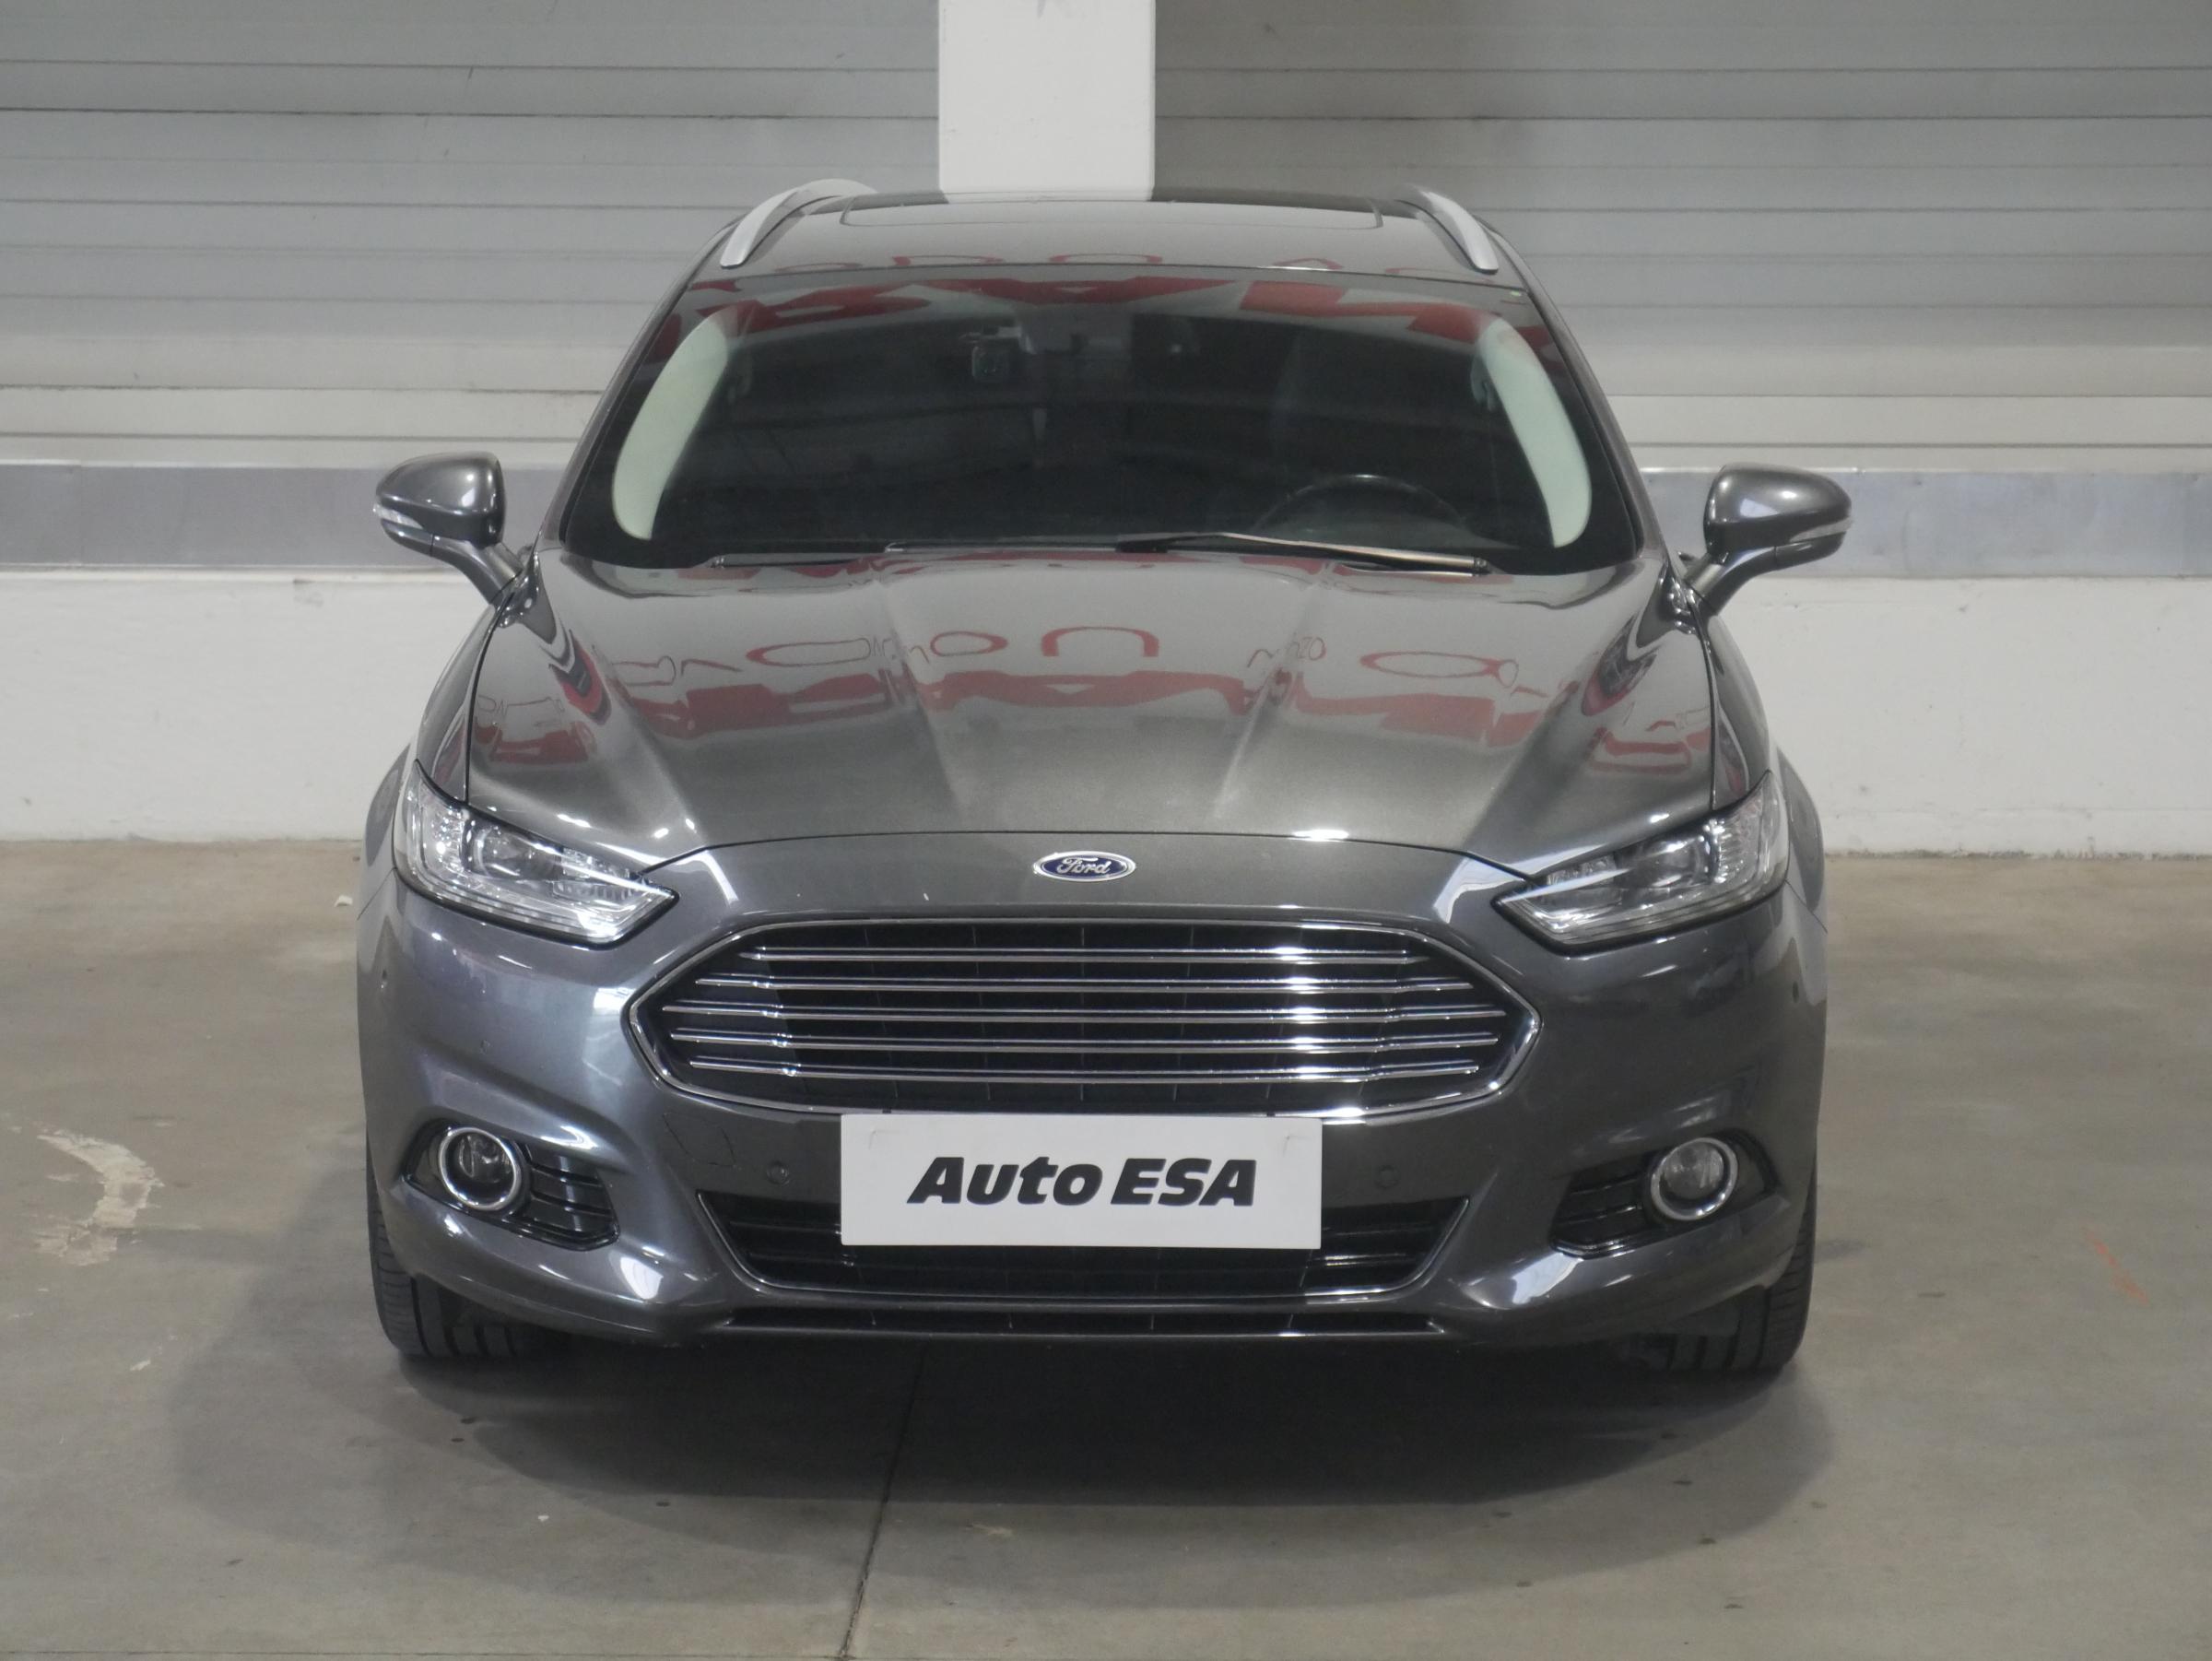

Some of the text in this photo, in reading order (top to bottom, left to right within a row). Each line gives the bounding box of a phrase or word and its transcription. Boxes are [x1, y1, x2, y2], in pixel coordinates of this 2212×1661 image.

[1056, 856, 1112, 874] Ford
[906, 1156, 1257, 1207] Auto ESA
